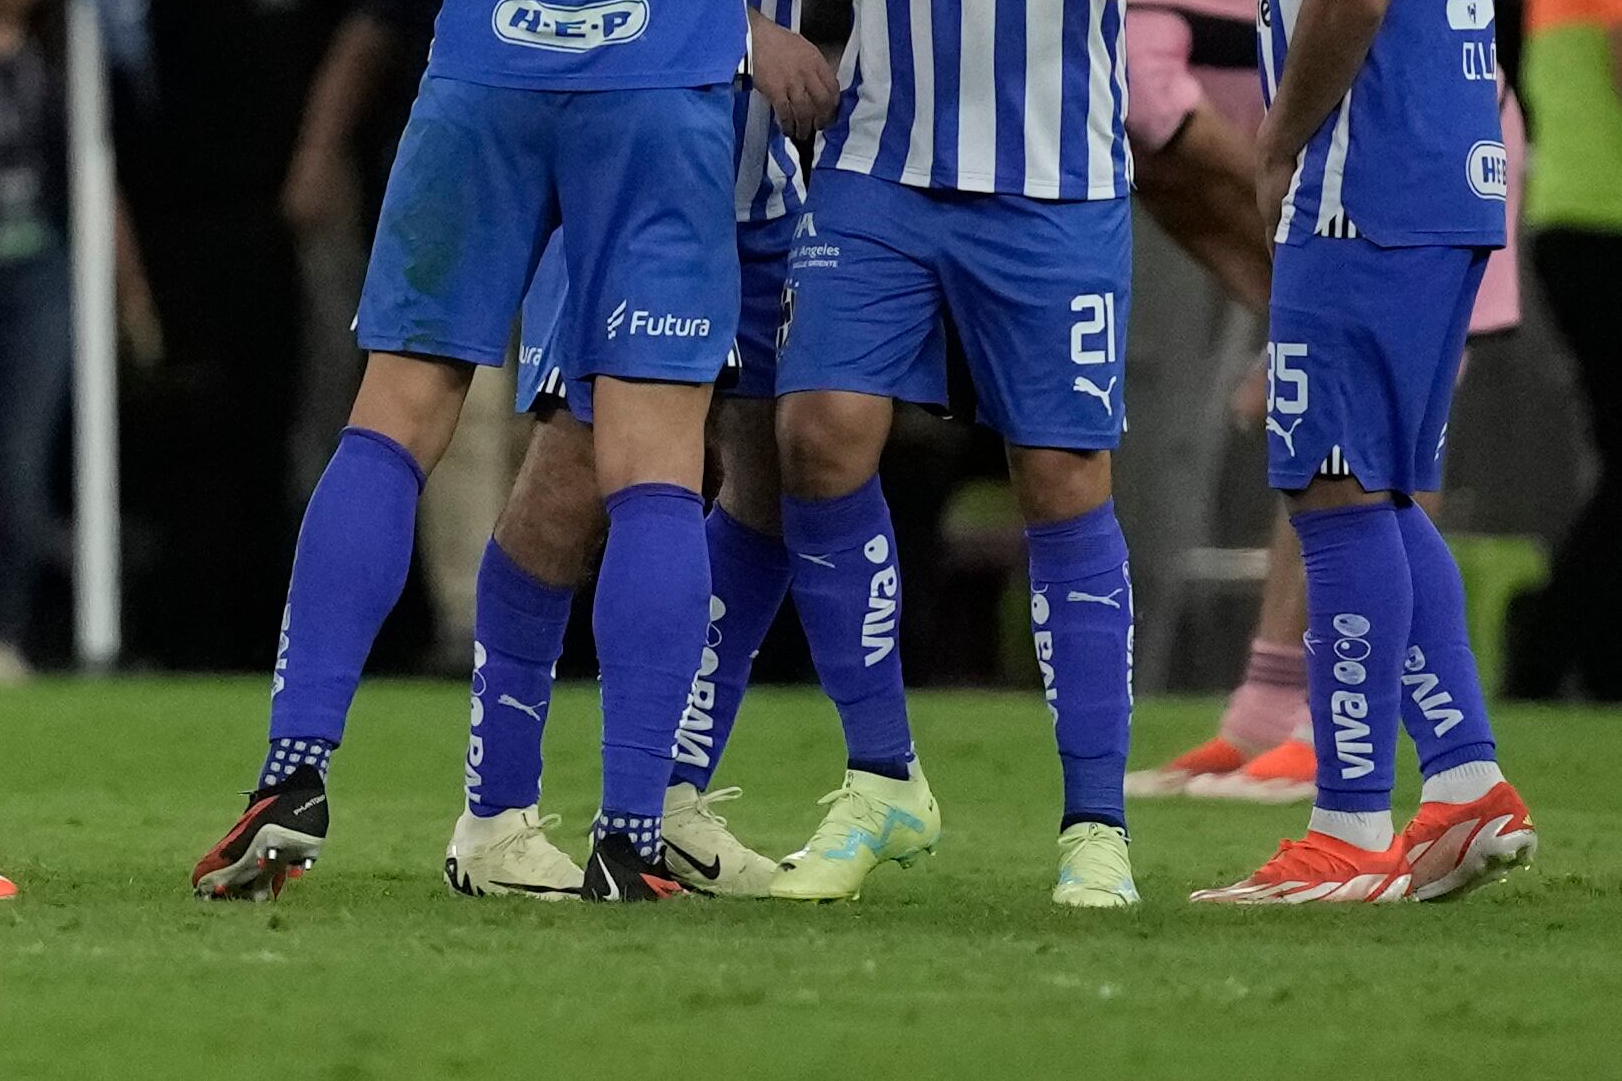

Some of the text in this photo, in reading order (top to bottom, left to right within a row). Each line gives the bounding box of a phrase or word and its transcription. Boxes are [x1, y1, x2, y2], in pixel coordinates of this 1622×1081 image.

[629, 310, 711, 337] Futura
[1070, 293, 1116, 365] 21
[861, 564, 898, 668] viva
[1331, 690, 1375, 780] viva
